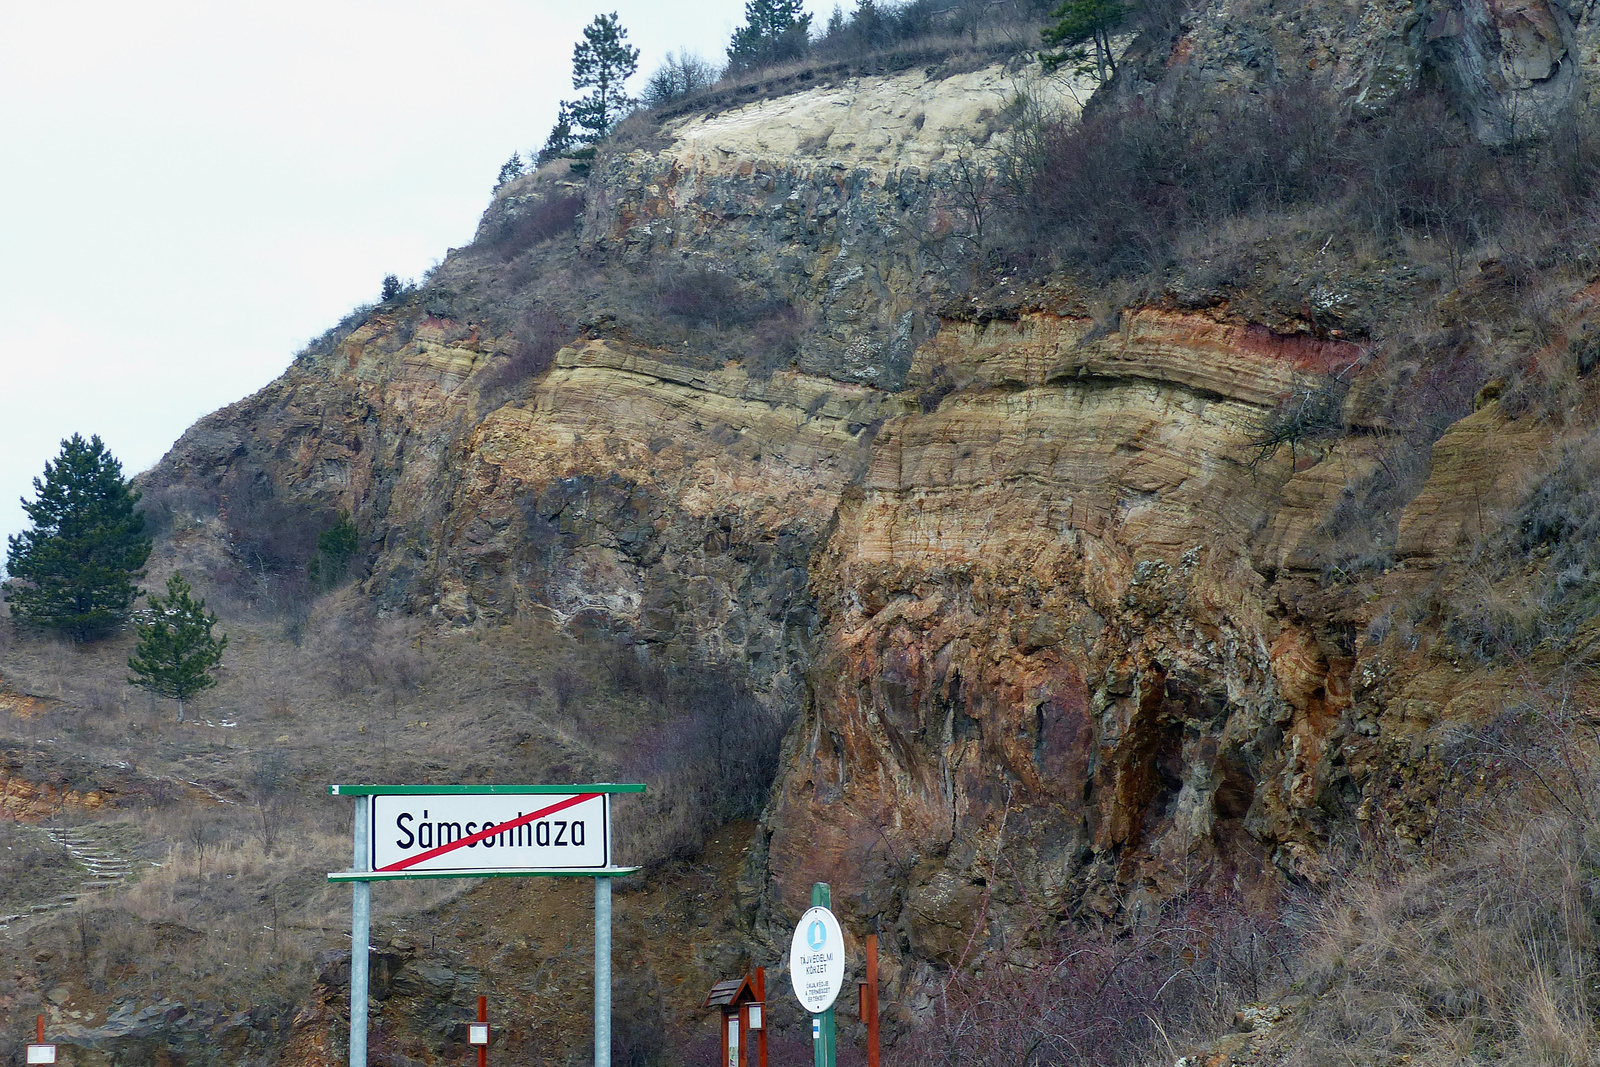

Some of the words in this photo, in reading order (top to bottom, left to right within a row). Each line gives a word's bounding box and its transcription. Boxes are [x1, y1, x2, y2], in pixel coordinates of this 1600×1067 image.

[396, 810, 585, 849] Sámsonháza
[800, 953, 833, 964] TÁJVÉDELMI
[806, 964, 827, 974] KÖRZET
